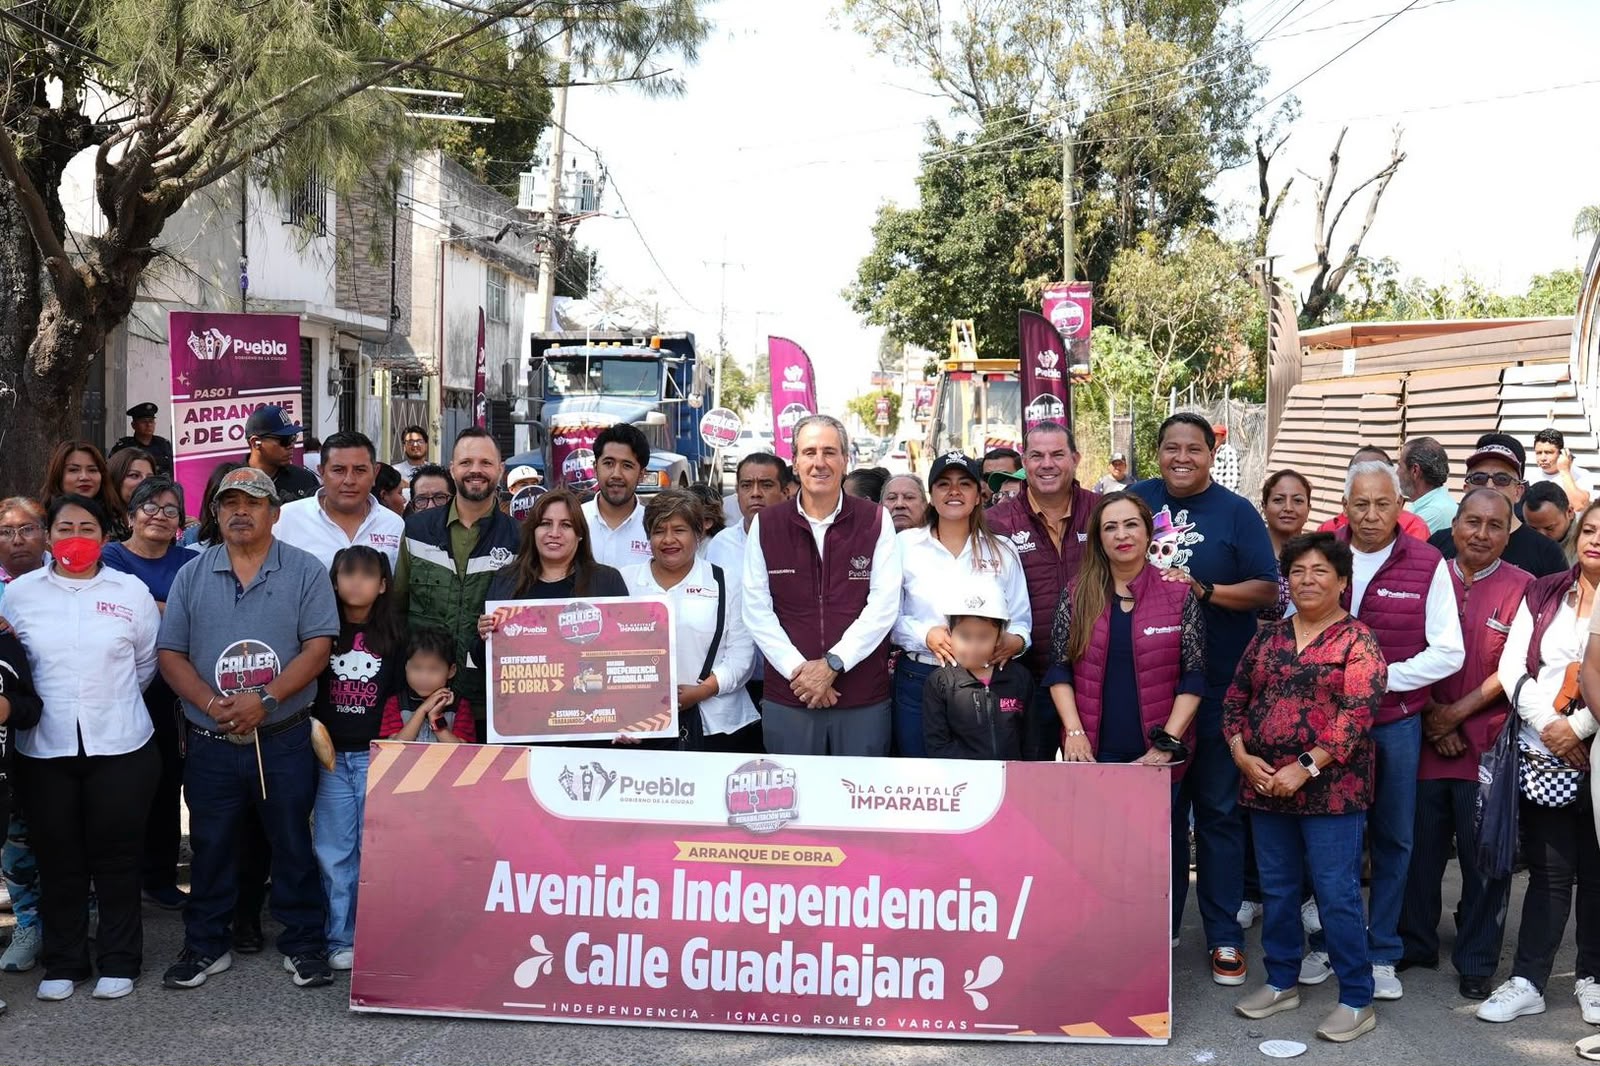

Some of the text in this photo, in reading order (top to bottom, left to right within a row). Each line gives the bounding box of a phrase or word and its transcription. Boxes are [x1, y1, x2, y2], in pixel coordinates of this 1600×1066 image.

[234, 338, 287, 355] Puebla
[1035, 367, 1061, 379] Puebla
[194, 387, 233, 399] PASO 1
[195, 426, 223, 445] DE
[562, 456, 596, 474] CALLE
[631, 540, 647, 549] IRV
[96, 601, 116, 611] IRV
[558, 609, 601, 626] CALLES
[523, 625, 548, 634] Puebla
[218, 652, 276, 673] CALLES
[500, 655, 547, 664] CERTIFICADO DE
[501, 664, 565, 679] ARRANQUE
[332, 680, 378, 695] HELLO
[501, 679, 550, 694] DE OBRA
[332, 692, 377, 707] KITTY
[336, 704, 366, 714] neon
[620, 776, 695, 797] Puebla
[727, 768, 797, 793] CALLES
[859, 785, 951, 796] LA CAPITAL
[851, 795, 961, 812] IMPARABLE
[688, 847, 833, 862] ARRANQUE DE OBRA
[484, 860, 1034, 940] Avenida Independencia /
[564, 931, 945, 1007] Calle Guadalajara
[553, 1002, 699, 1019] INDEPENDENCIA
[726, 1011, 802, 1024] IGNACIO
[813, 1014, 887, 1027] ROMERO
[898, 1018, 968, 1031] VARGAS
